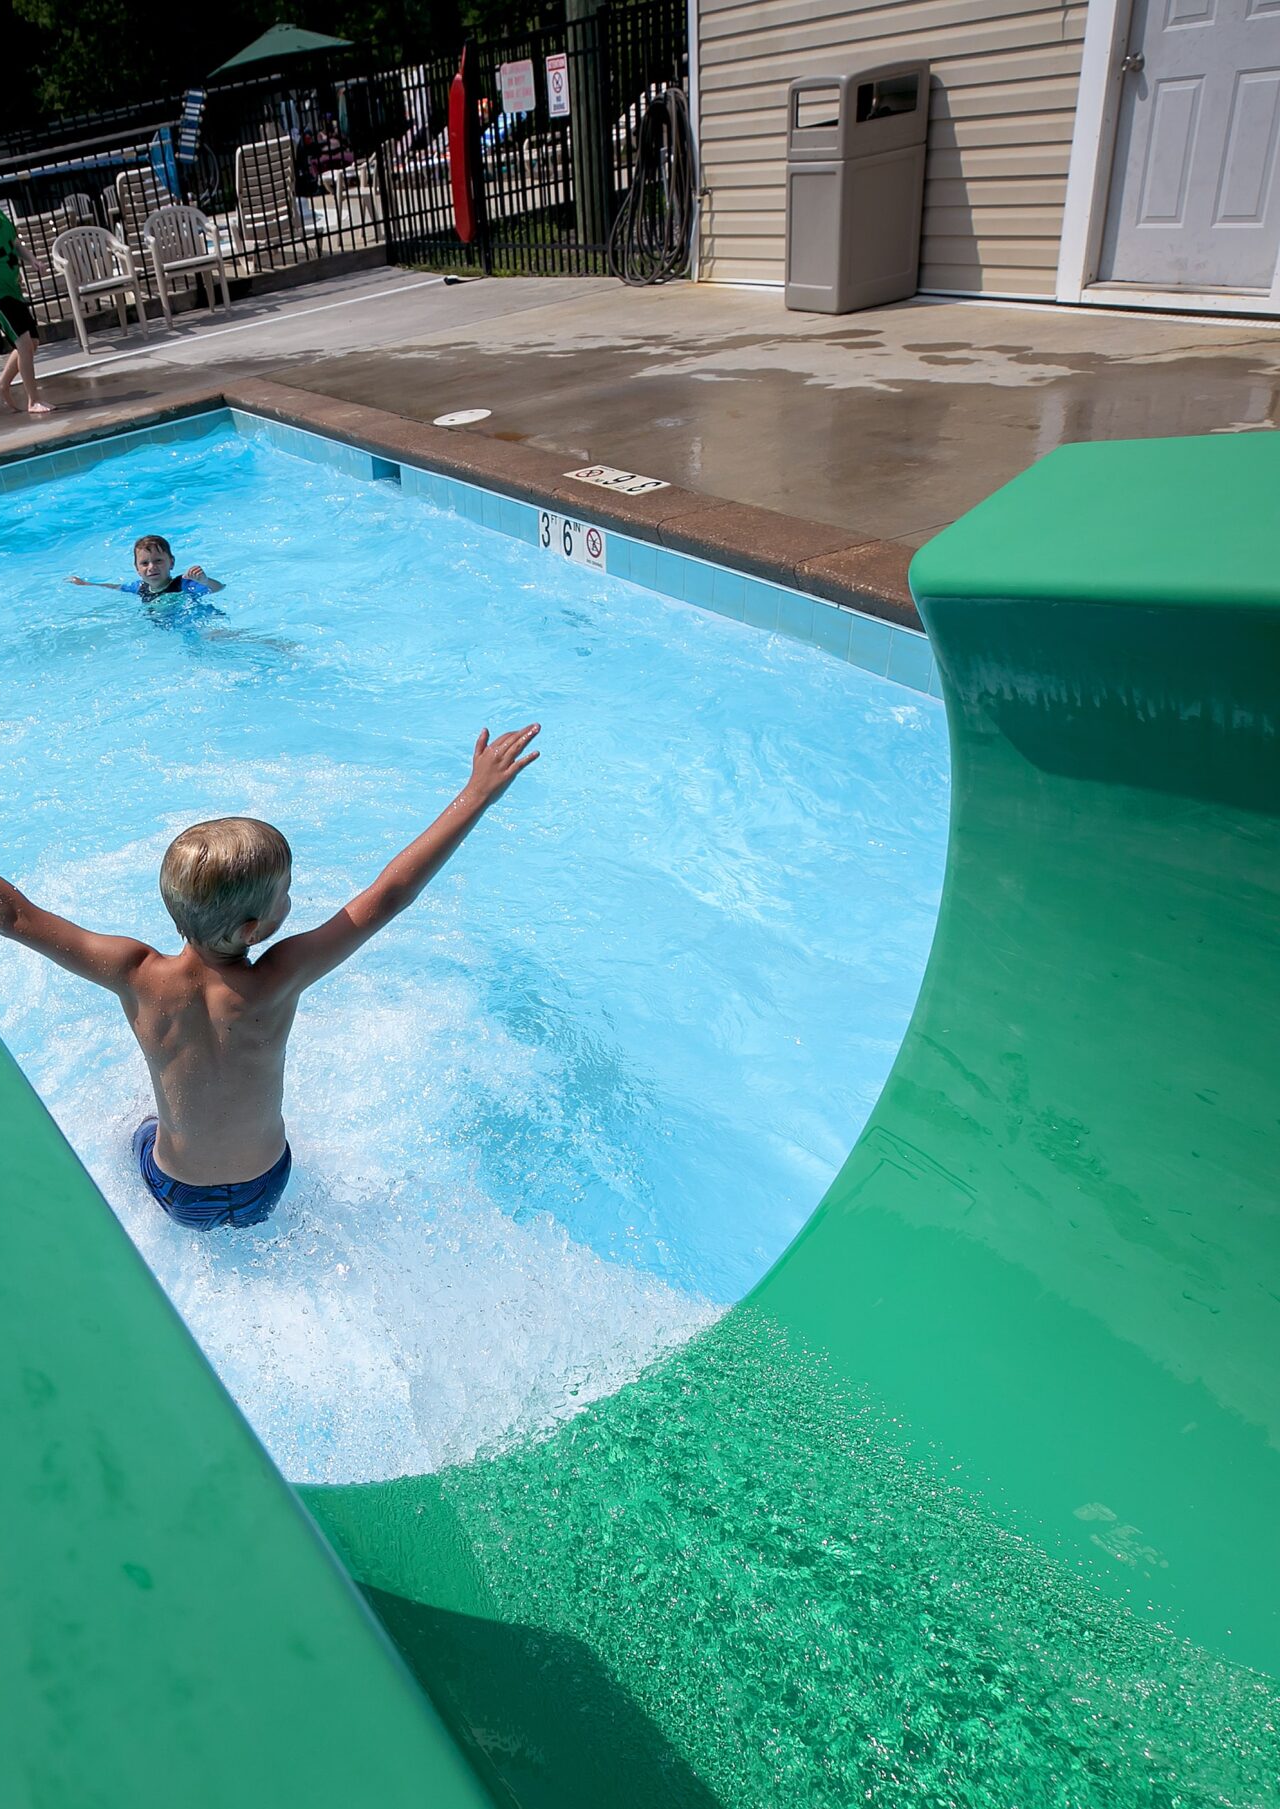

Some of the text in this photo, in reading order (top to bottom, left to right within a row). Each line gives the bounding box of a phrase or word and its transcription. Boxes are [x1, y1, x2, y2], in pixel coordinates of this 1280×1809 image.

[602, 475, 637, 485] 6
[626, 481, 662, 492] 3
[541, 512, 581, 556] 3 FT 6 IN
